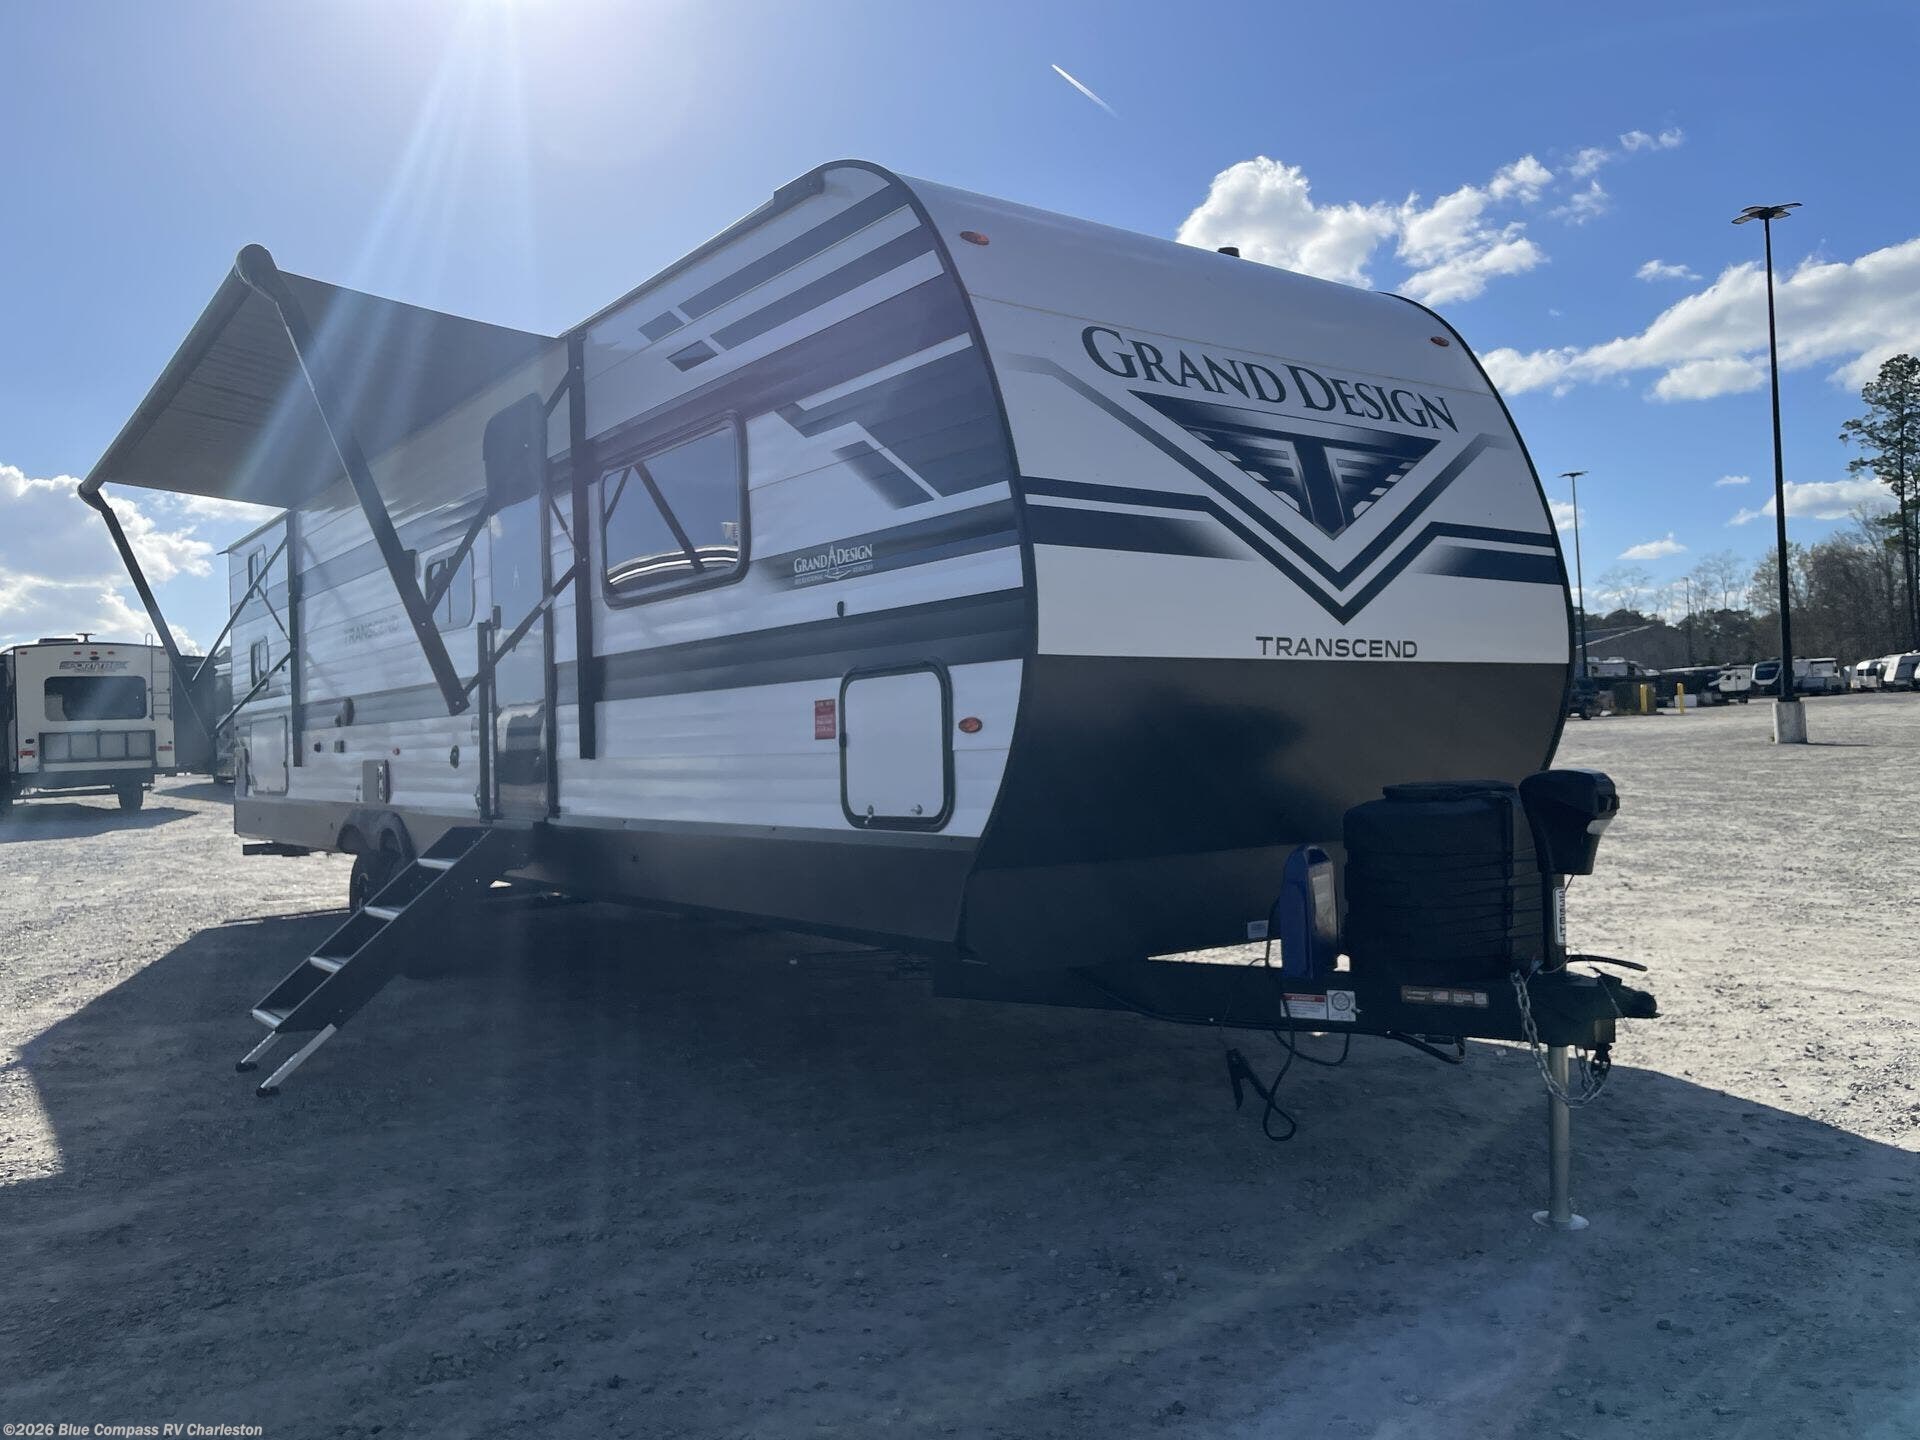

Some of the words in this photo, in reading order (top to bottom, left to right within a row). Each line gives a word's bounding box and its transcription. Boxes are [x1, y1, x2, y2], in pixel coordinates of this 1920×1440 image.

[1081, 325, 1287, 404] GRAND
[1281, 363, 1460, 433] DESIGN
[793, 554, 828, 573] GRAND
[836, 543, 873, 564] DESIGN
[1255, 636, 1418, 659] TRANSCEND
